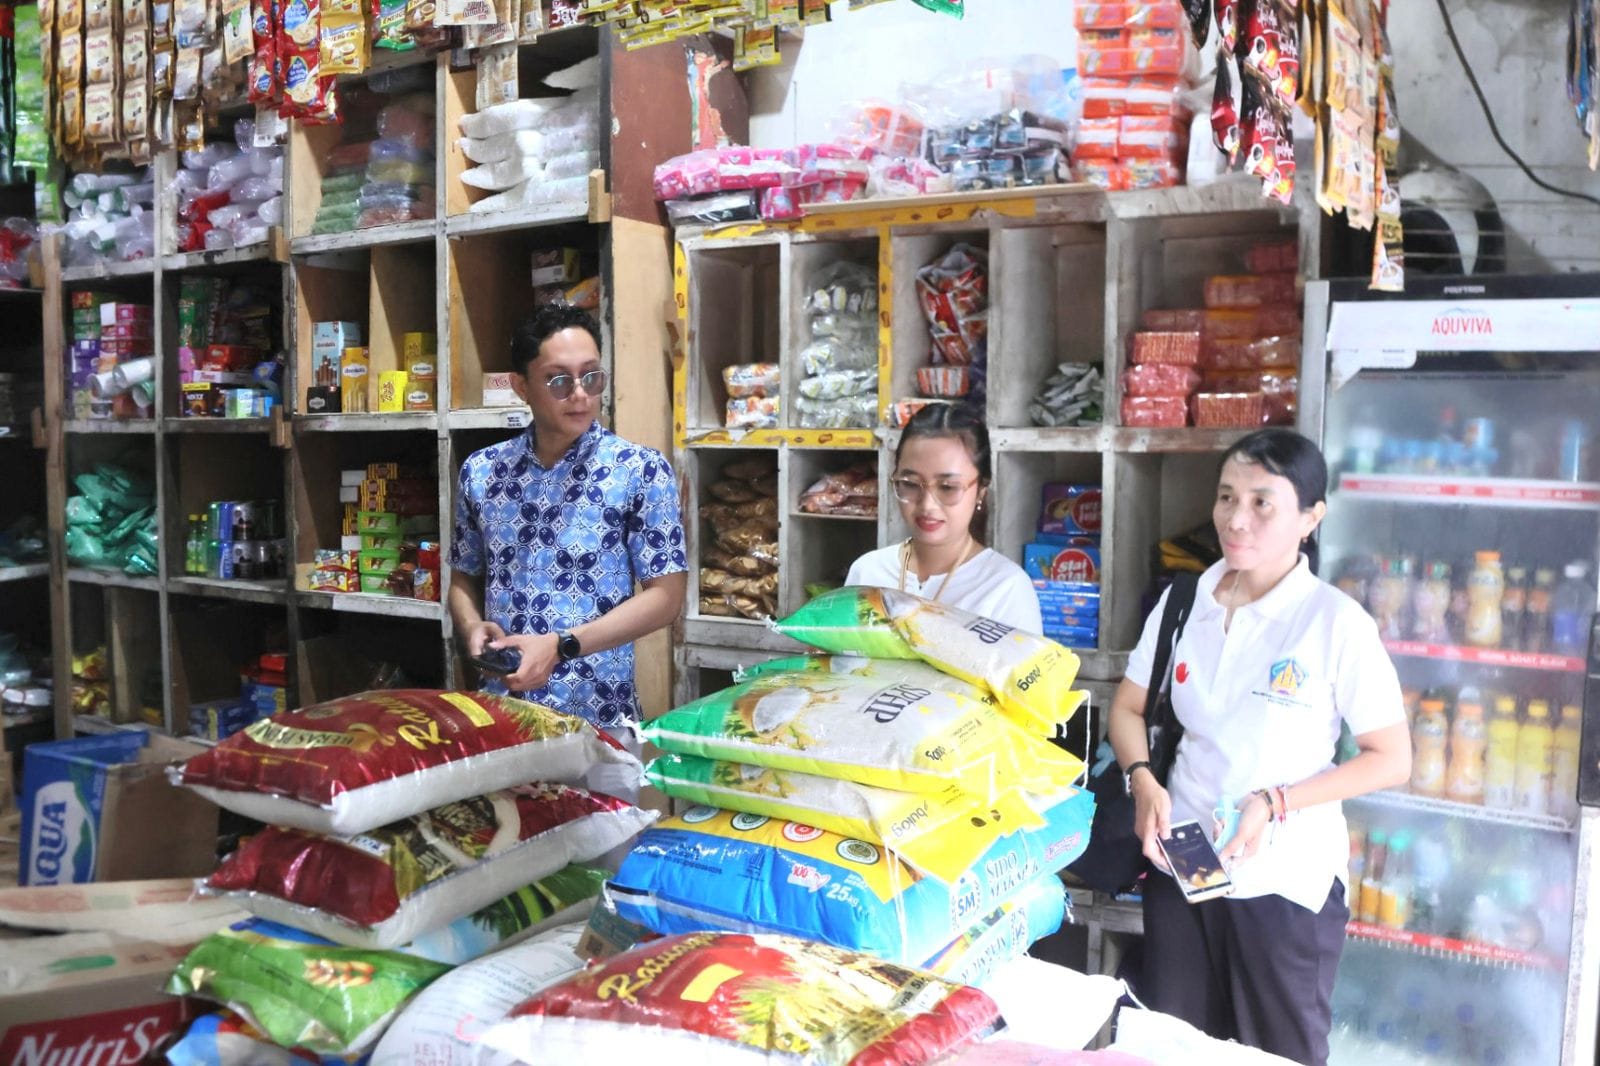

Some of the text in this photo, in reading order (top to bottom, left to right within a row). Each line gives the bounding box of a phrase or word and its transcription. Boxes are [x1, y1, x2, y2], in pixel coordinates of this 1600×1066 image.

[1431, 317, 1493, 335] AQUVIVA
[863, 683, 932, 724] SPHP
[34, 801, 68, 887] QUA
[957, 891, 976, 917] SM
[11, 1016, 173, 1066] NutriS
